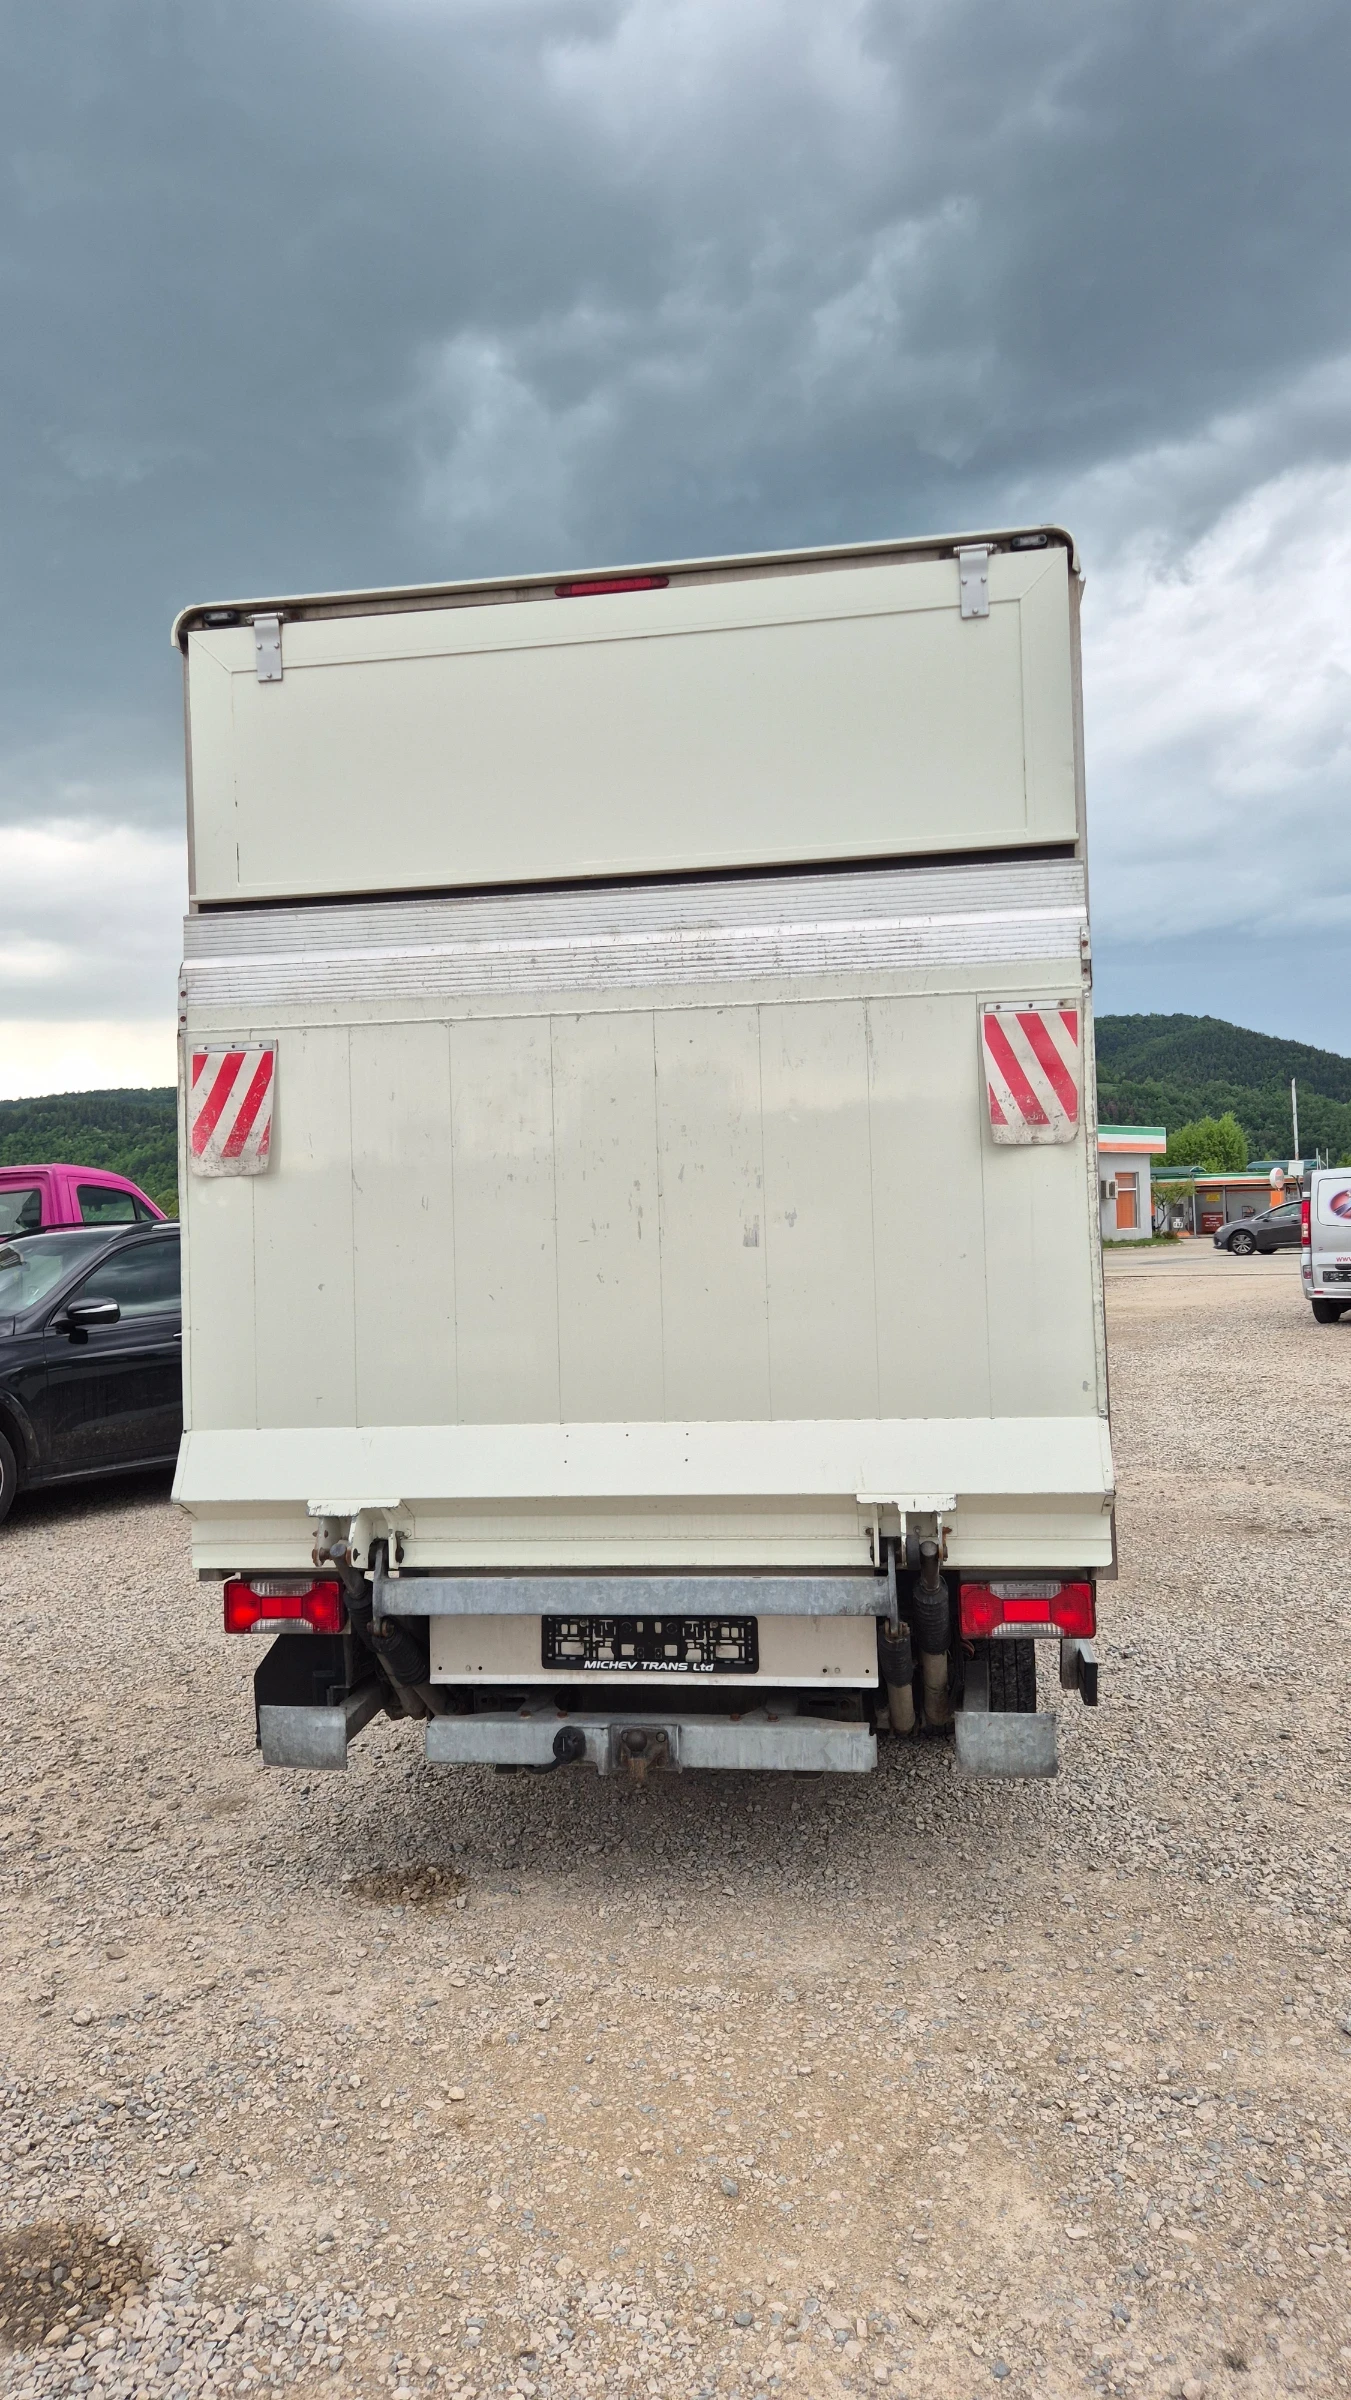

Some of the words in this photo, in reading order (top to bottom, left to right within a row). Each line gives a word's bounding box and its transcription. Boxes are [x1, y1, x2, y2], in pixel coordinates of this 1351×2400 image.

[584, 1661, 638, 1670] MICHEV
[641, 1661, 688, 1671] TRANS
[693, 1663, 714, 1672] Ltd
